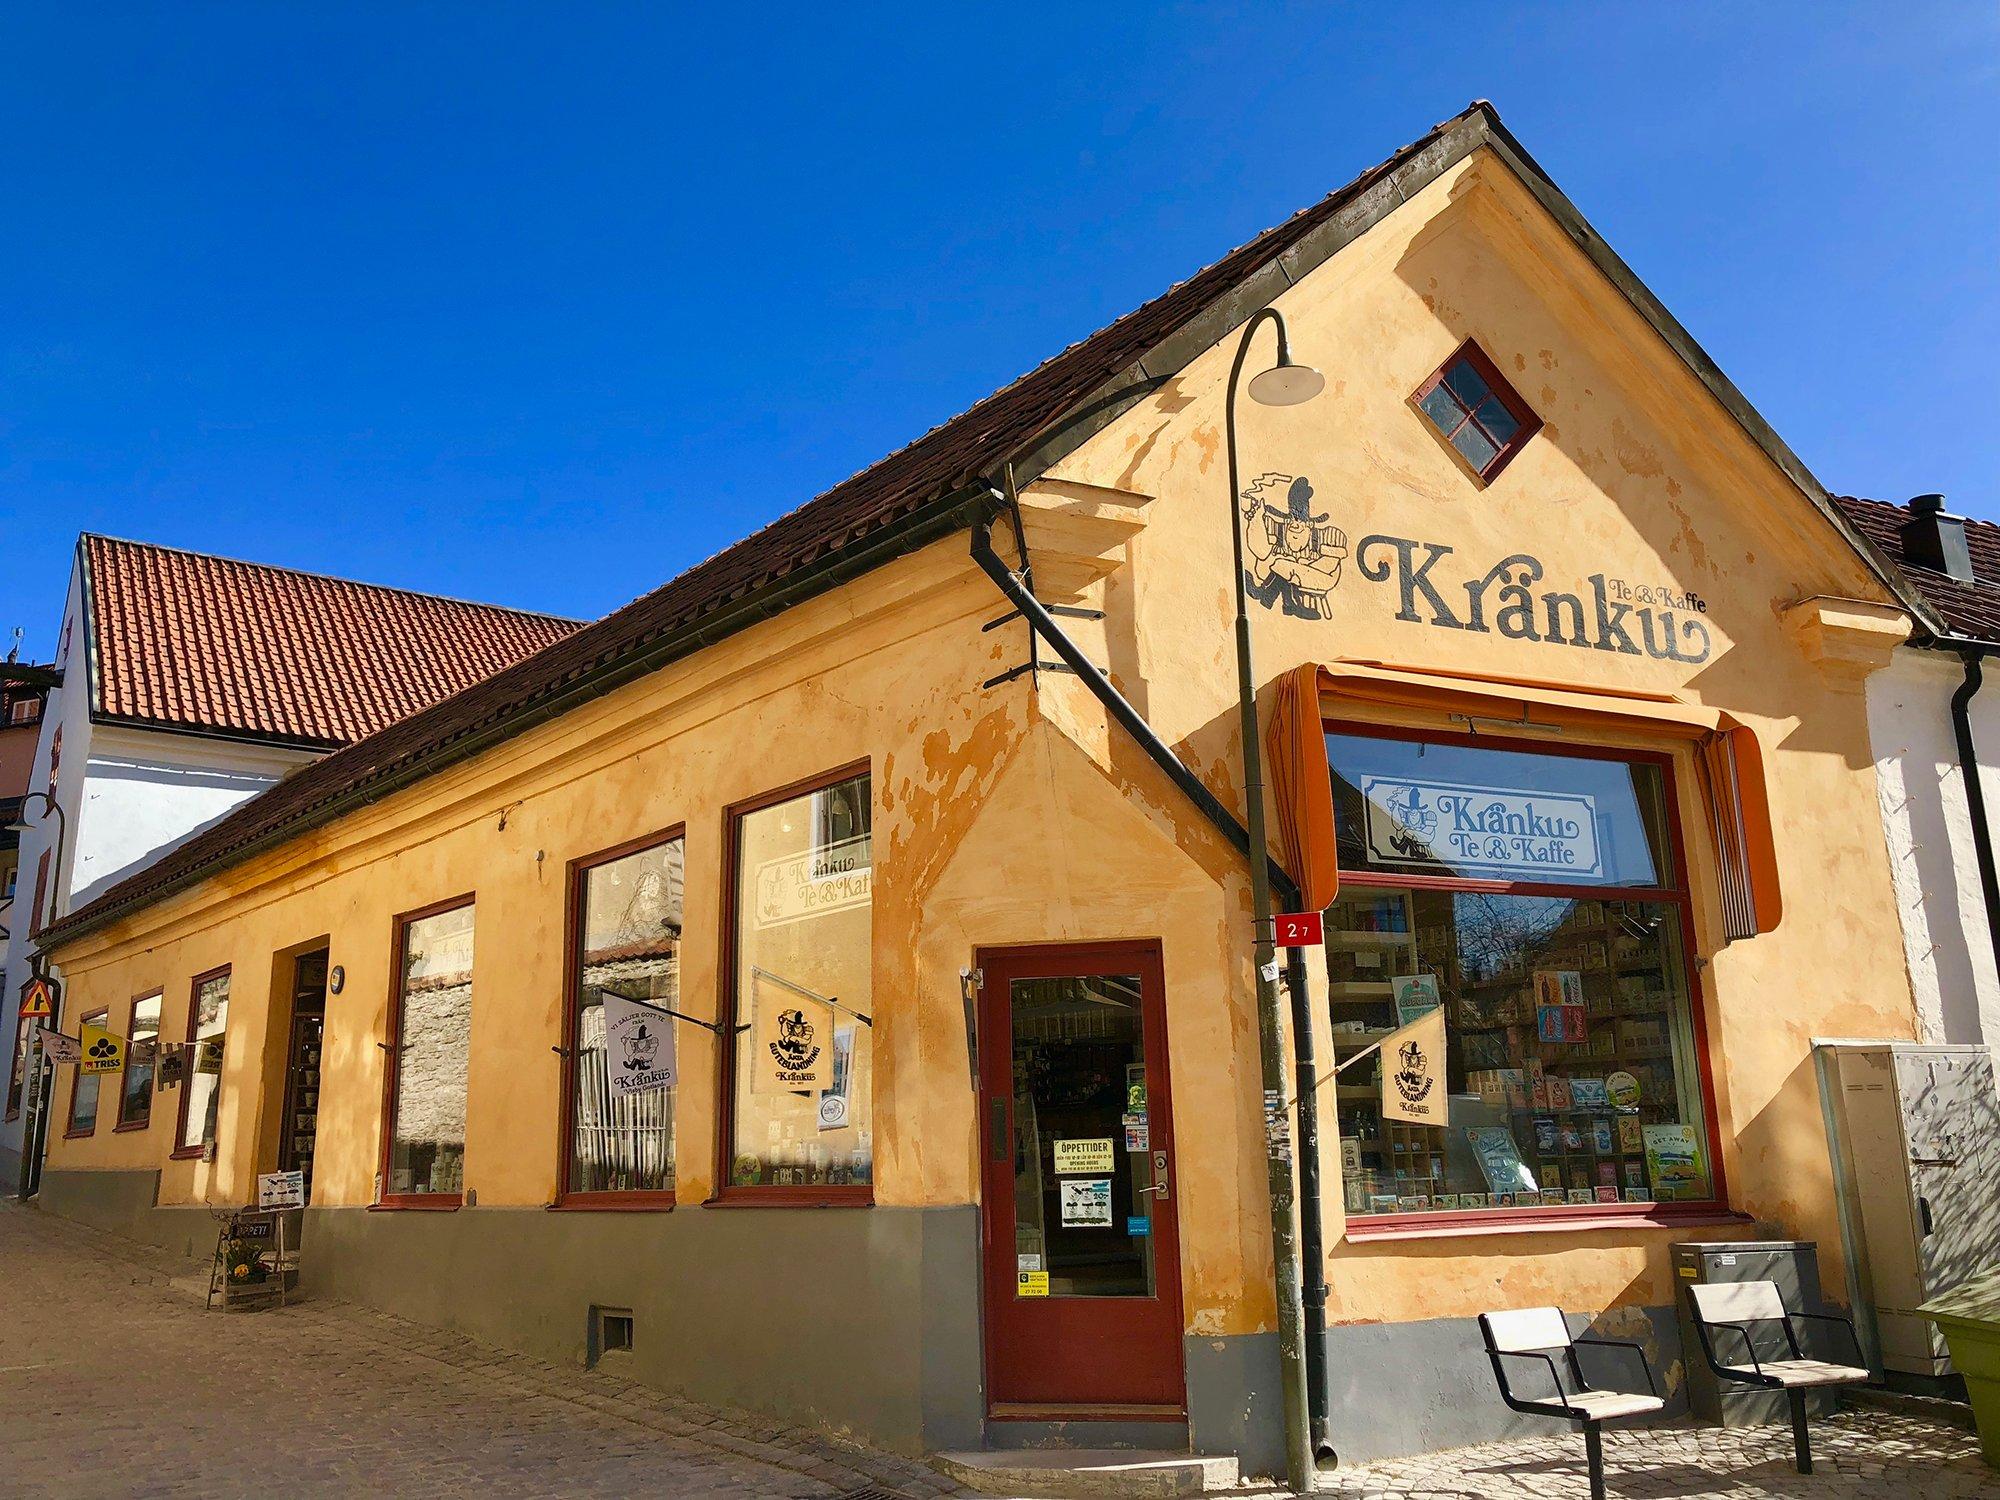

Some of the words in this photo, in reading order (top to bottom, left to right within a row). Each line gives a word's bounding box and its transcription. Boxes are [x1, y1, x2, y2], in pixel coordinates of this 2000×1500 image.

[1357, 534, 1711, 665] Kränku
[1609, 579, 1632, 601] Te
[1635, 585, 1657, 605] &
[1656, 587, 1706, 613] Kaffe
[1437, 795, 1579, 839] Kränku
[1449, 833, 1479, 859] Te
[1483, 835, 1511, 860] &
[1511, 838, 1575, 864] Kaffe
[798, 885, 817, 908] Te
[819, 881, 837, 903] &
[836, 872, 871, 899] Kaf
[93, 1059, 121, 1069] TRISS
[769, 1042, 820, 1070] GUTEBLANDNING
[613, 1071, 671, 1089] Kränku
[775, 1072, 816, 1081] Kränku
[1394, 1074, 1433, 1102] GUTEBLANDNING
[1061, 1142, 1108, 1153] ÖPPETTIDER
[1653, 1137, 1667, 1145] GET
[1669, 1136, 1690, 1144] AWAY
